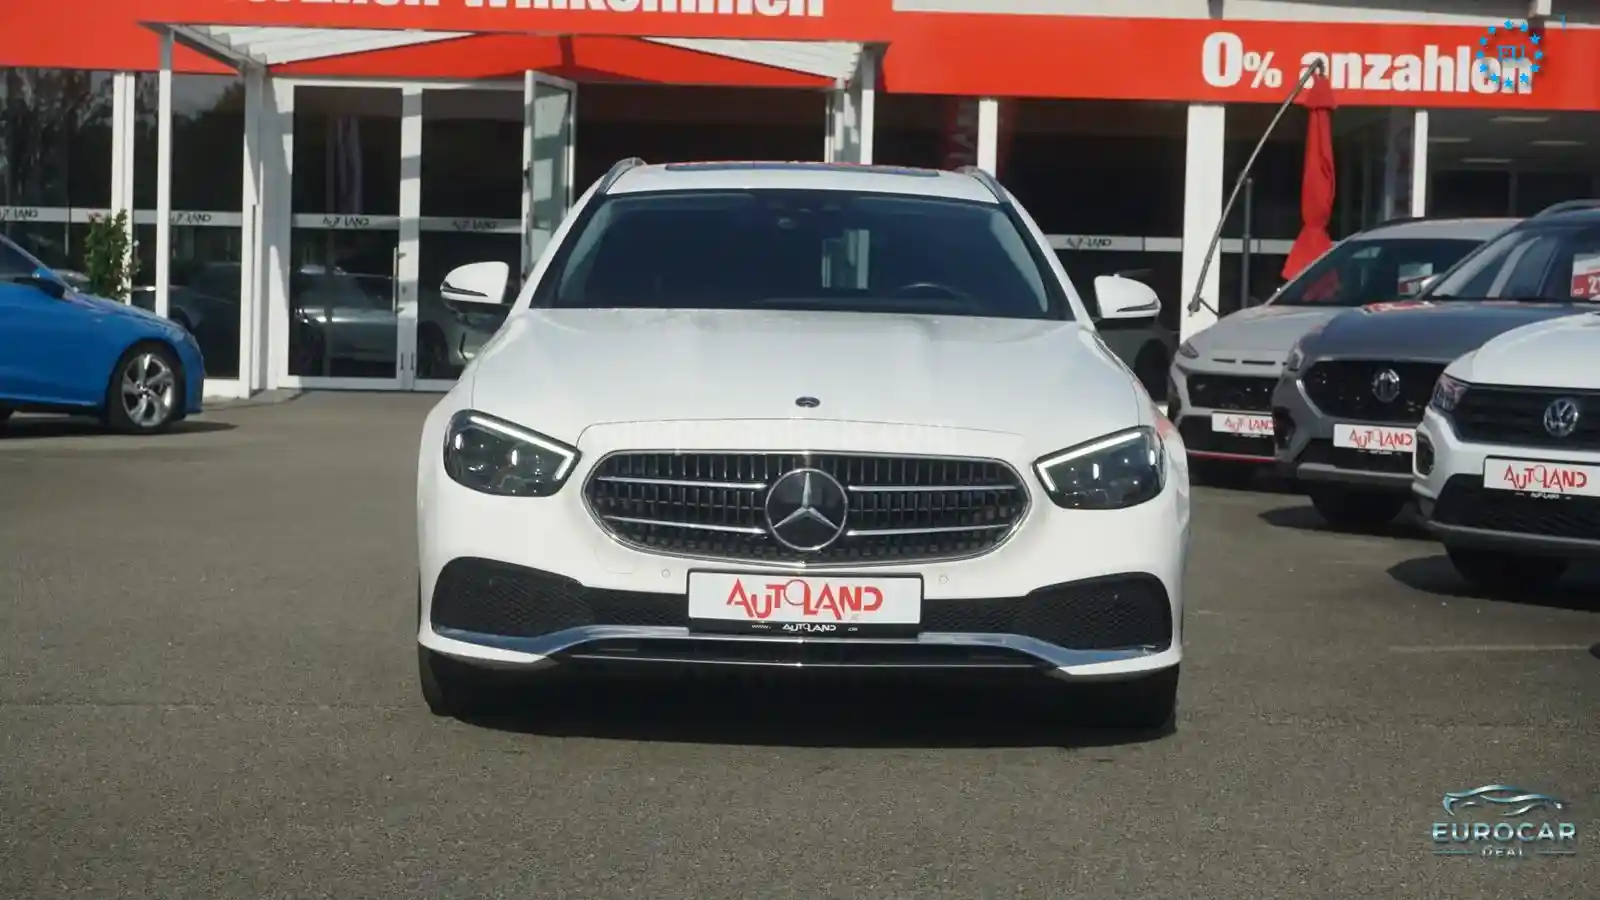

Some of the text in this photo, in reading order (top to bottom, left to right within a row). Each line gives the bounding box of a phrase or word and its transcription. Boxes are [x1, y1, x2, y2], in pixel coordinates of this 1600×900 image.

[1202, 31, 1533, 94] 0% anzahlen
[1225, 416, 1275, 432] AUTLAND
[1503, 464, 1587, 492] AUTOLAND
[726, 578, 884, 620] AUTOLAND
[782, 623, 837, 632] AUTOLAND
